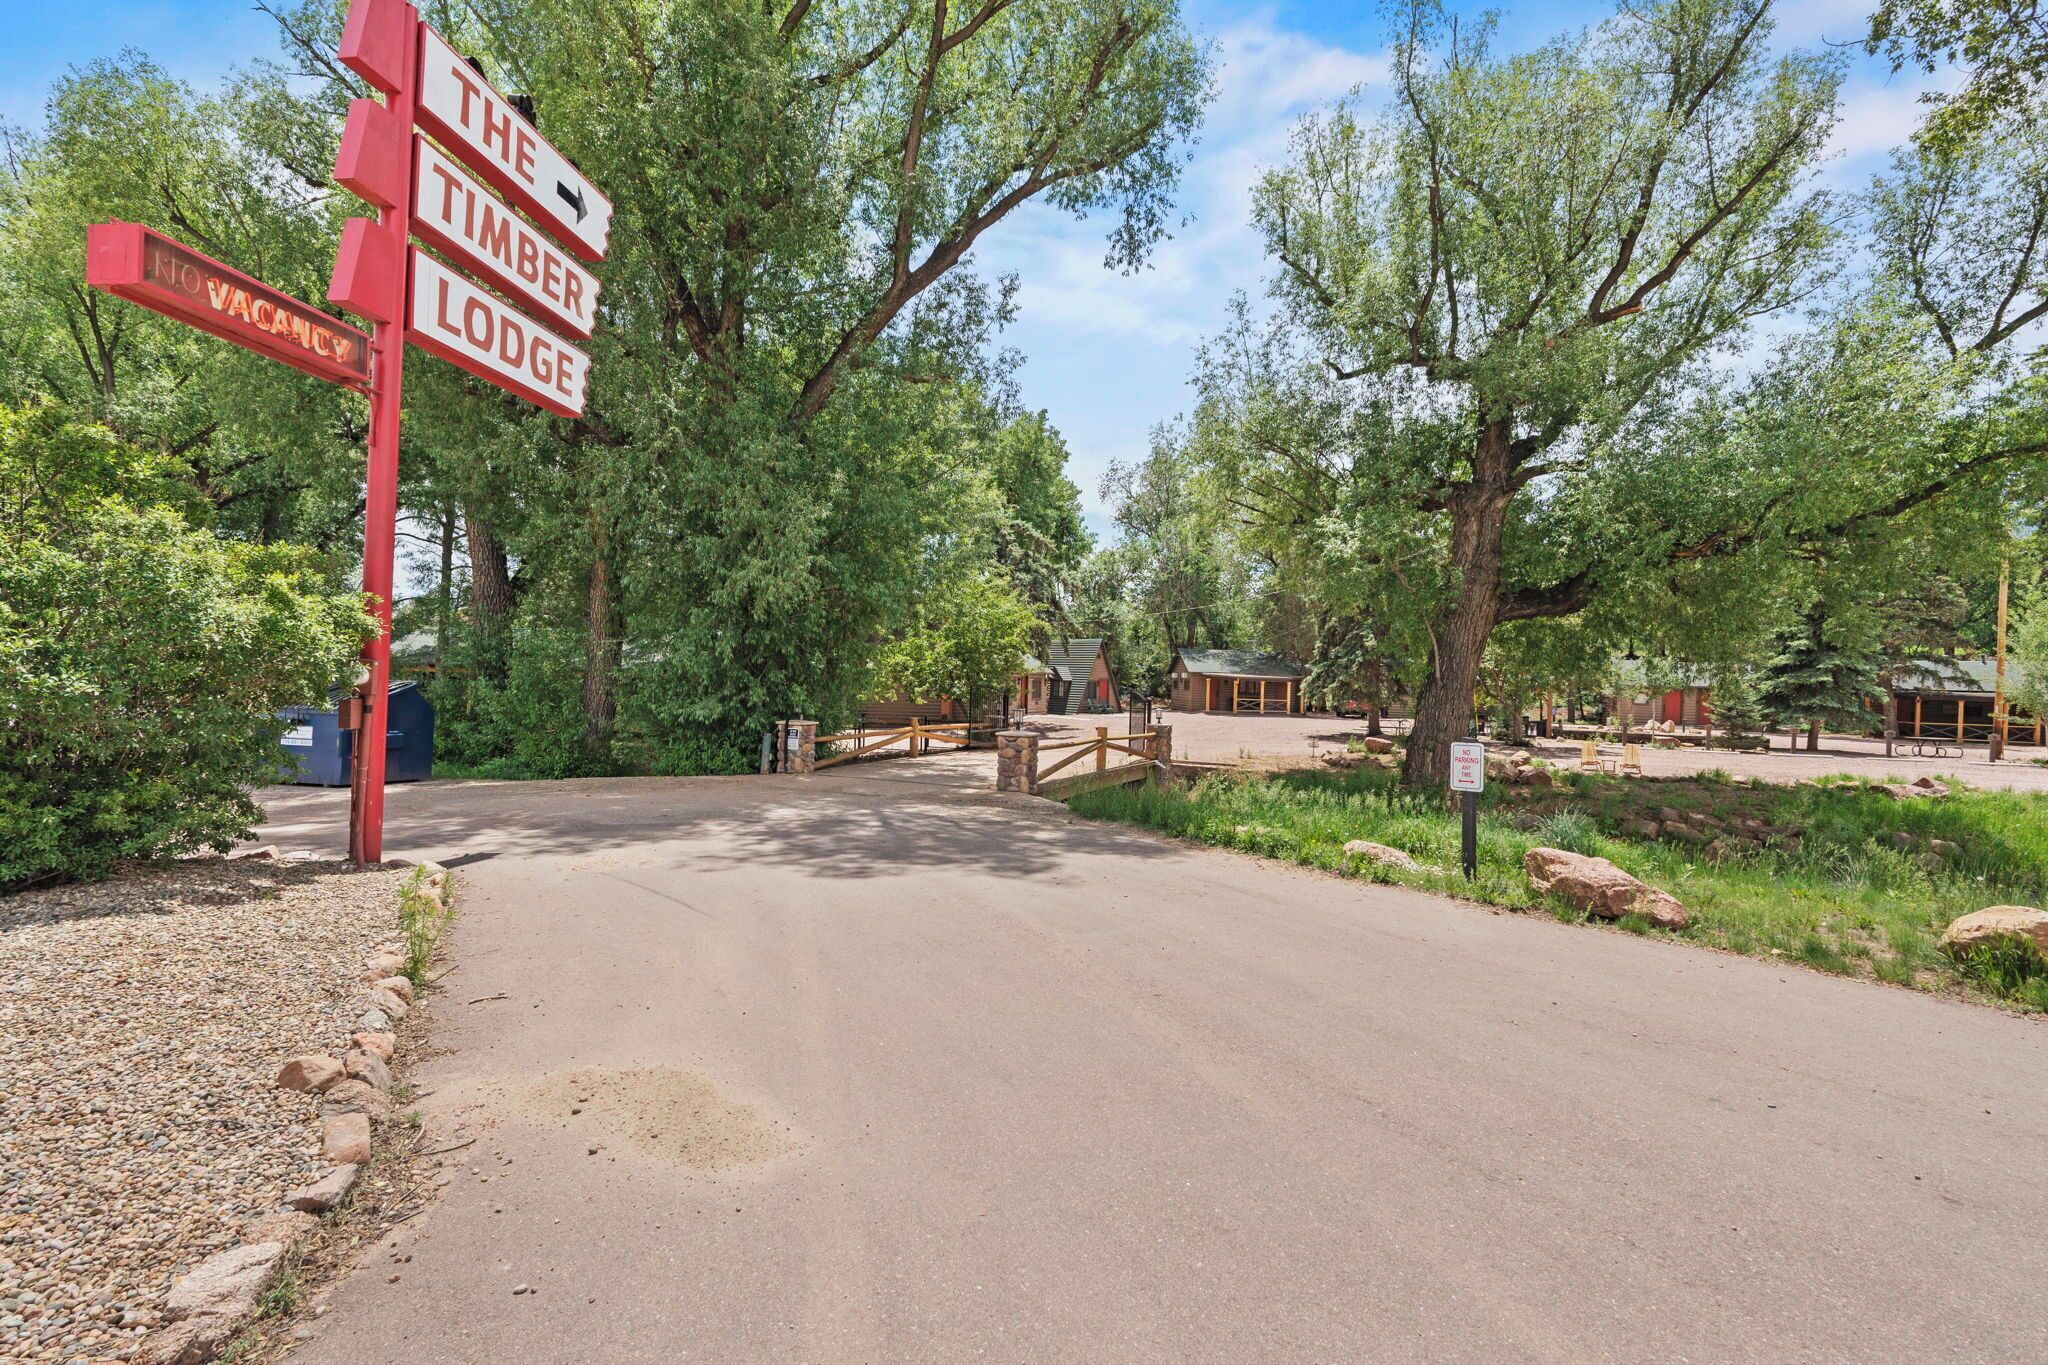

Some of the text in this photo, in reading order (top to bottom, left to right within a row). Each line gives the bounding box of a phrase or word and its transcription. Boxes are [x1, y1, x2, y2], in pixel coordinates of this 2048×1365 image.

[452, 66, 536, 186] THE
[433, 162, 584, 320] TIMBER
[155, 251, 352, 363] NO VACANCY
[437, 276, 573, 397] LODGE
[1455, 756, 1479, 764] PARKING
